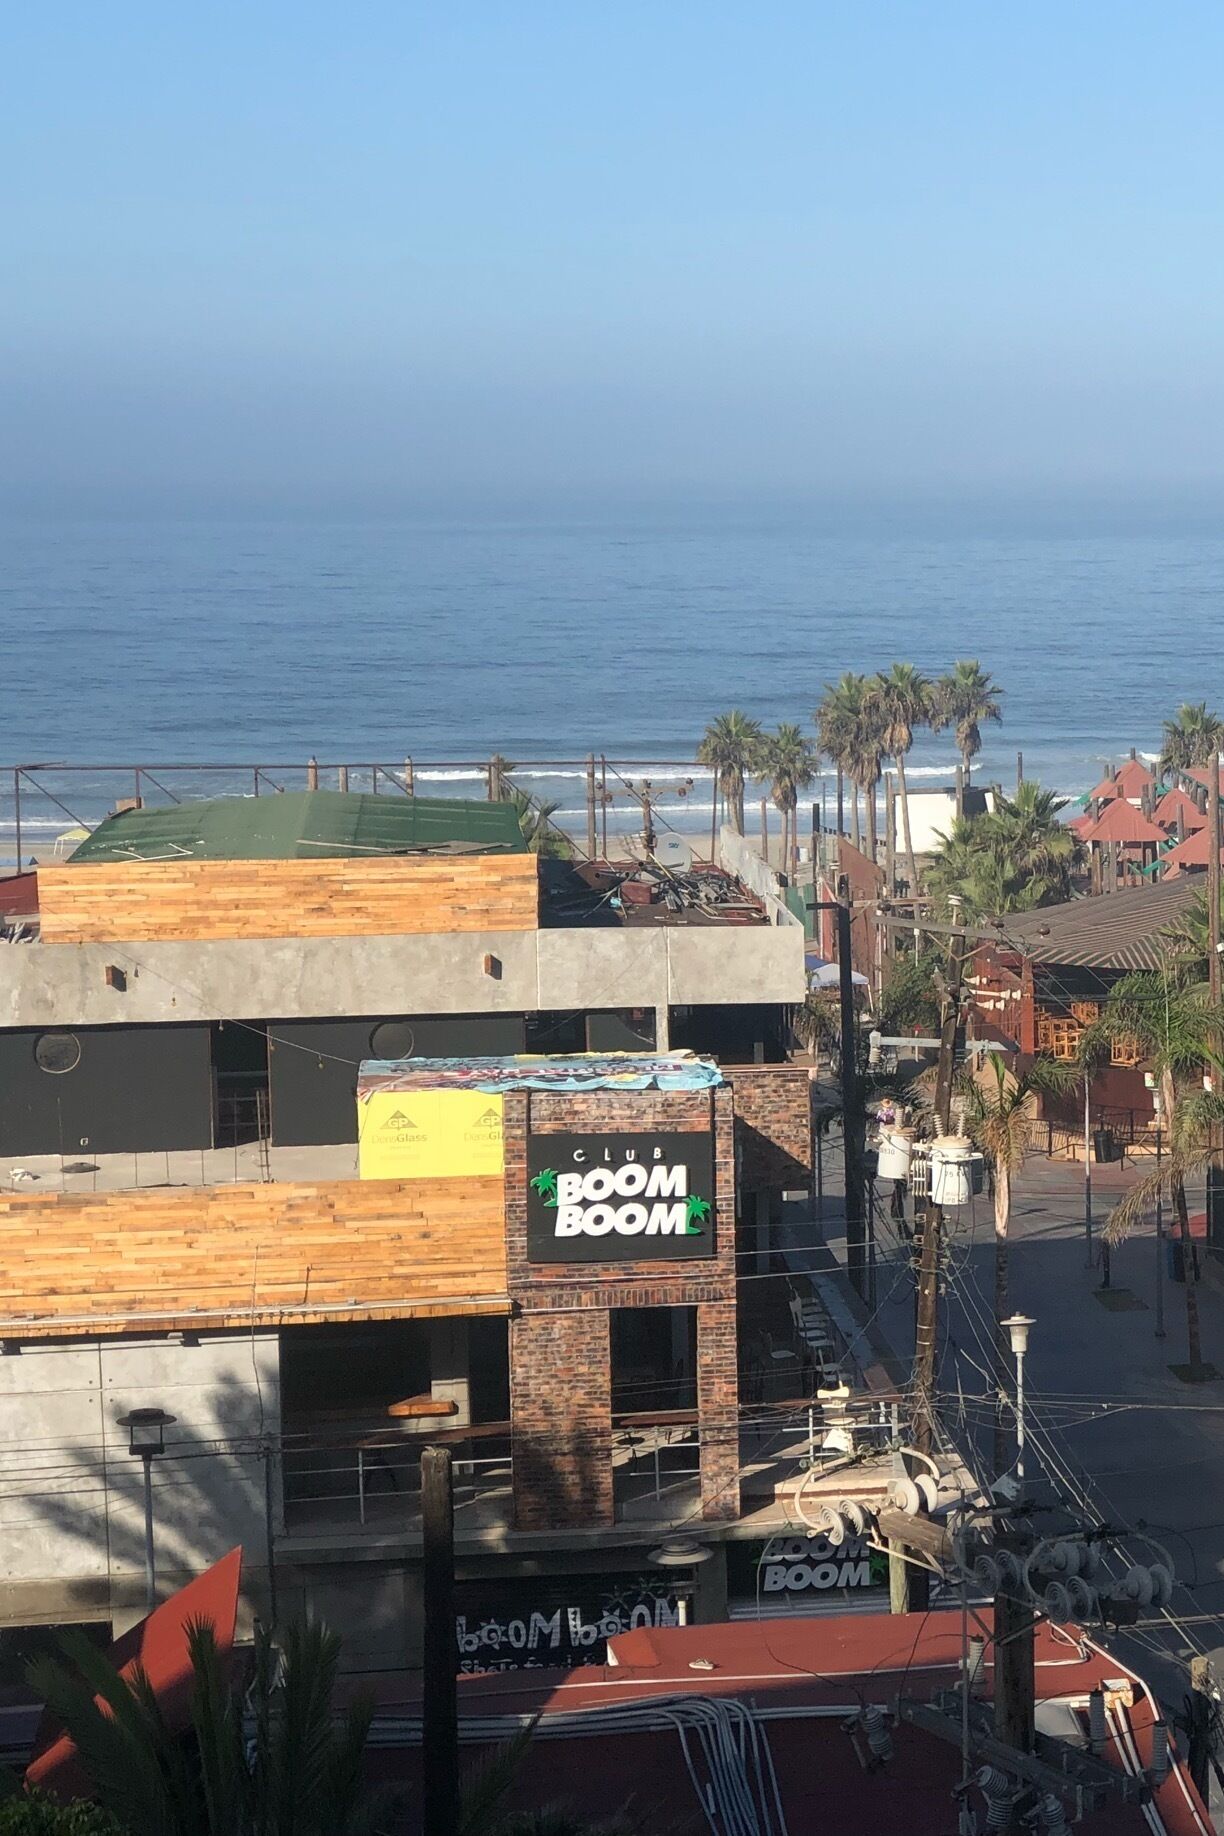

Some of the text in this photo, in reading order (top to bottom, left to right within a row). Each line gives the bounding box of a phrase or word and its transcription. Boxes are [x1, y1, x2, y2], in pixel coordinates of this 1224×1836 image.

[387, 1118, 408, 1129] GP
[372, 1133, 428, 1144] DensGlass
[573, 1146, 663, 1162] CLUB
[556, 1163, 687, 1206] BOOM
[554, 1203, 687, 1237] BOOM
[763, 1561, 870, 1592] BOOM
